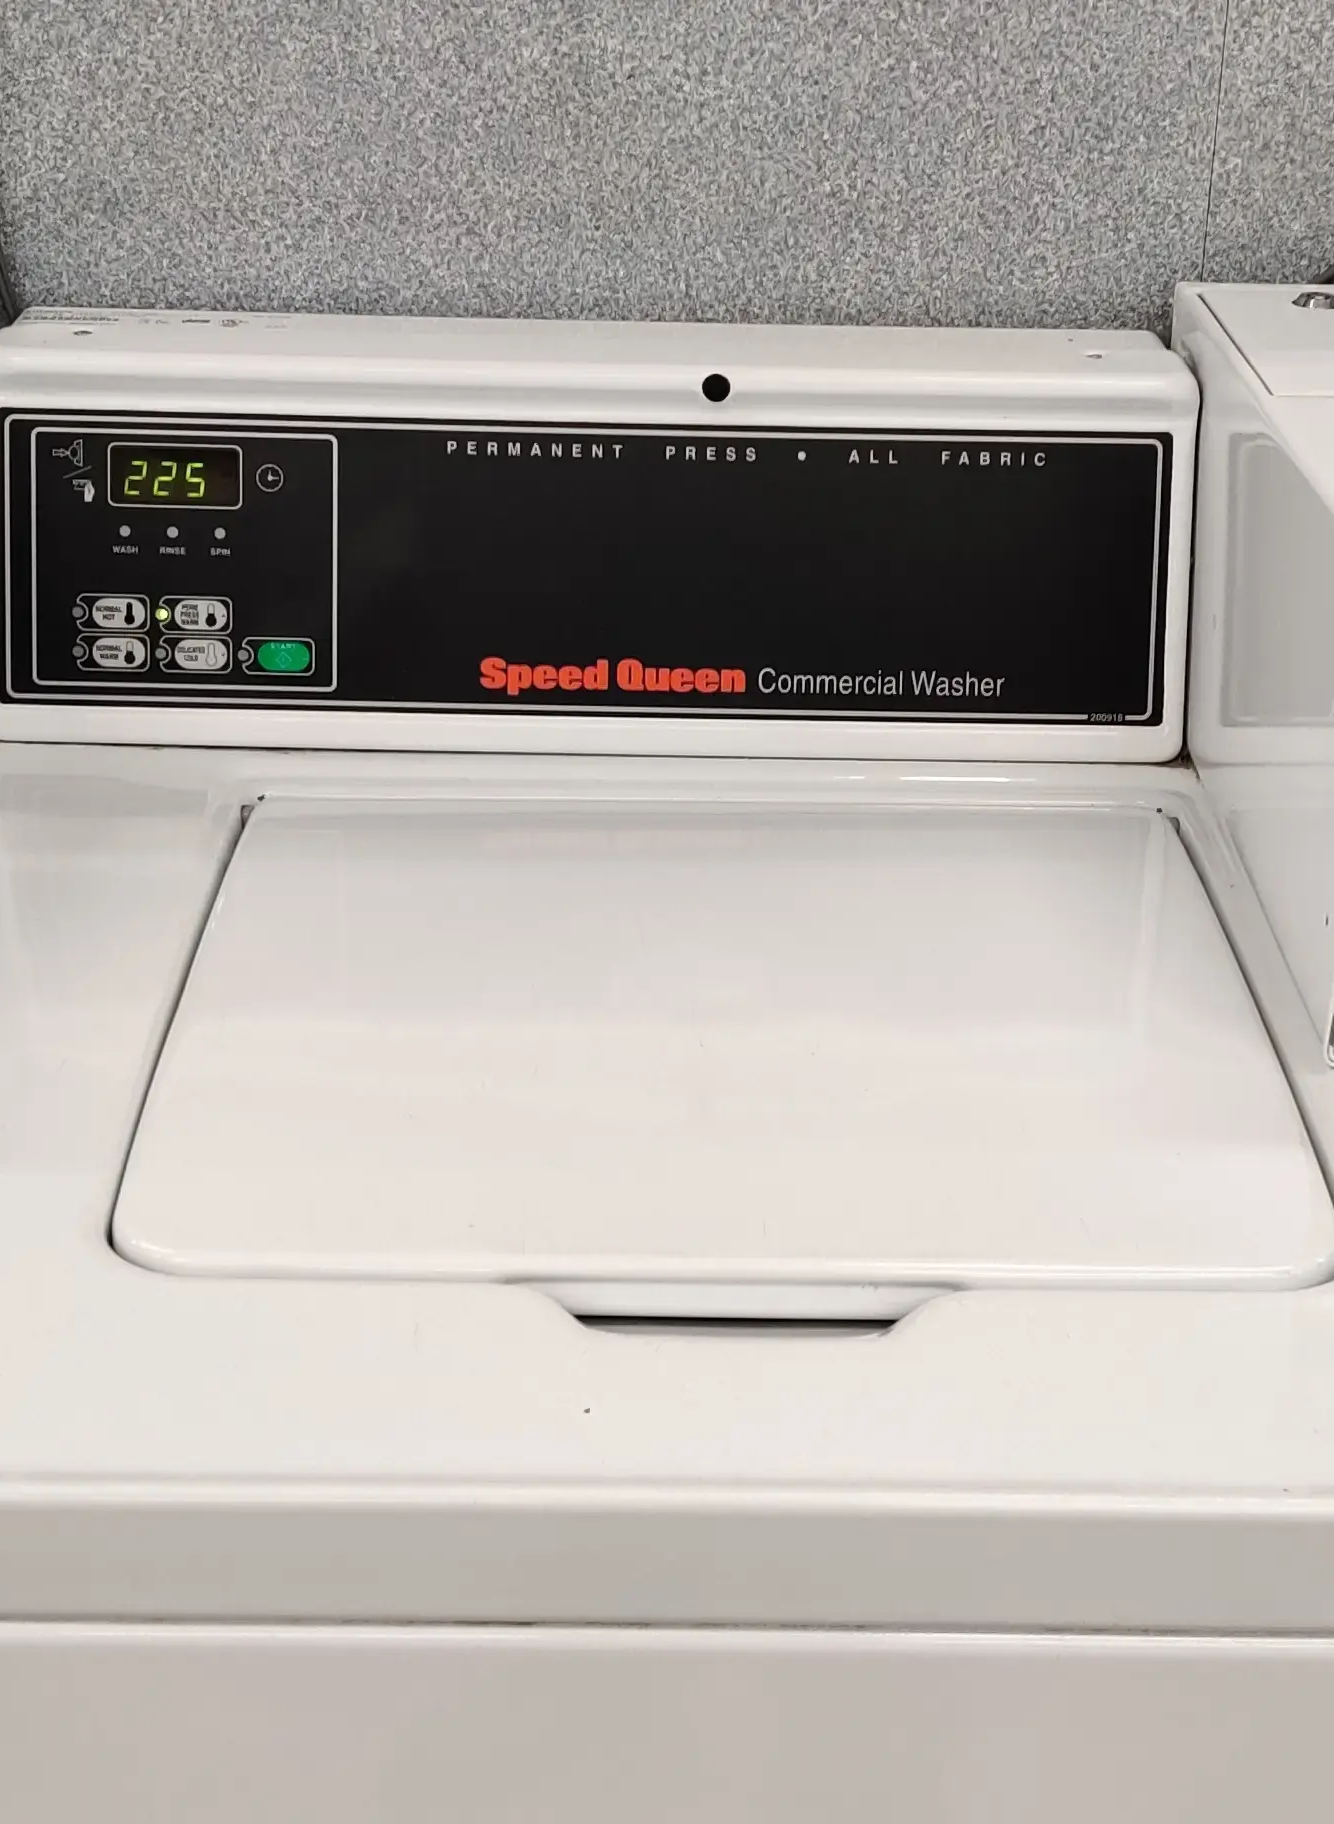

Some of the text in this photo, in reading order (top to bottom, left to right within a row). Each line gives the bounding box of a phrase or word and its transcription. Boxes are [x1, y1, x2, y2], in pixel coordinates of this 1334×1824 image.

[447, 441, 756, 462] PERMANENT PRESS
[848, 449, 1046, 467] ALL FABRIC
[124, 461, 205, 497] 225
[112, 545, 139, 554] WASH
[479, 657, 746, 696] Speed Queen
[758, 666, 1005, 697] Commercial Washer
